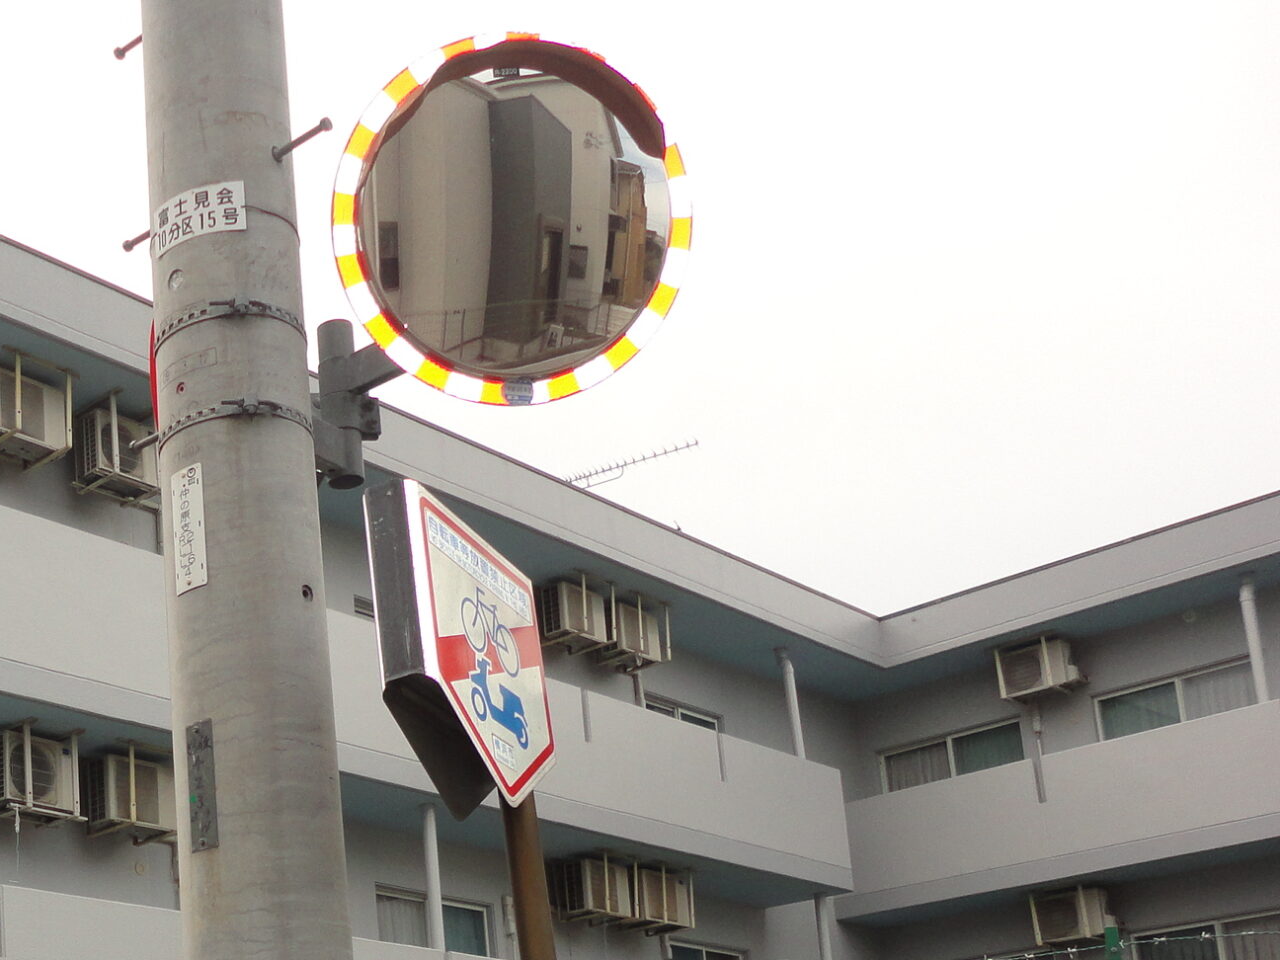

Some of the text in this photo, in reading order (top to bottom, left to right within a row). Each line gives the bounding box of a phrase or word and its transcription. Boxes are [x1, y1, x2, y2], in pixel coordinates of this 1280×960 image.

[157, 207, 239, 250] 10分区15号
[158, 187, 233, 228] 富士見会
